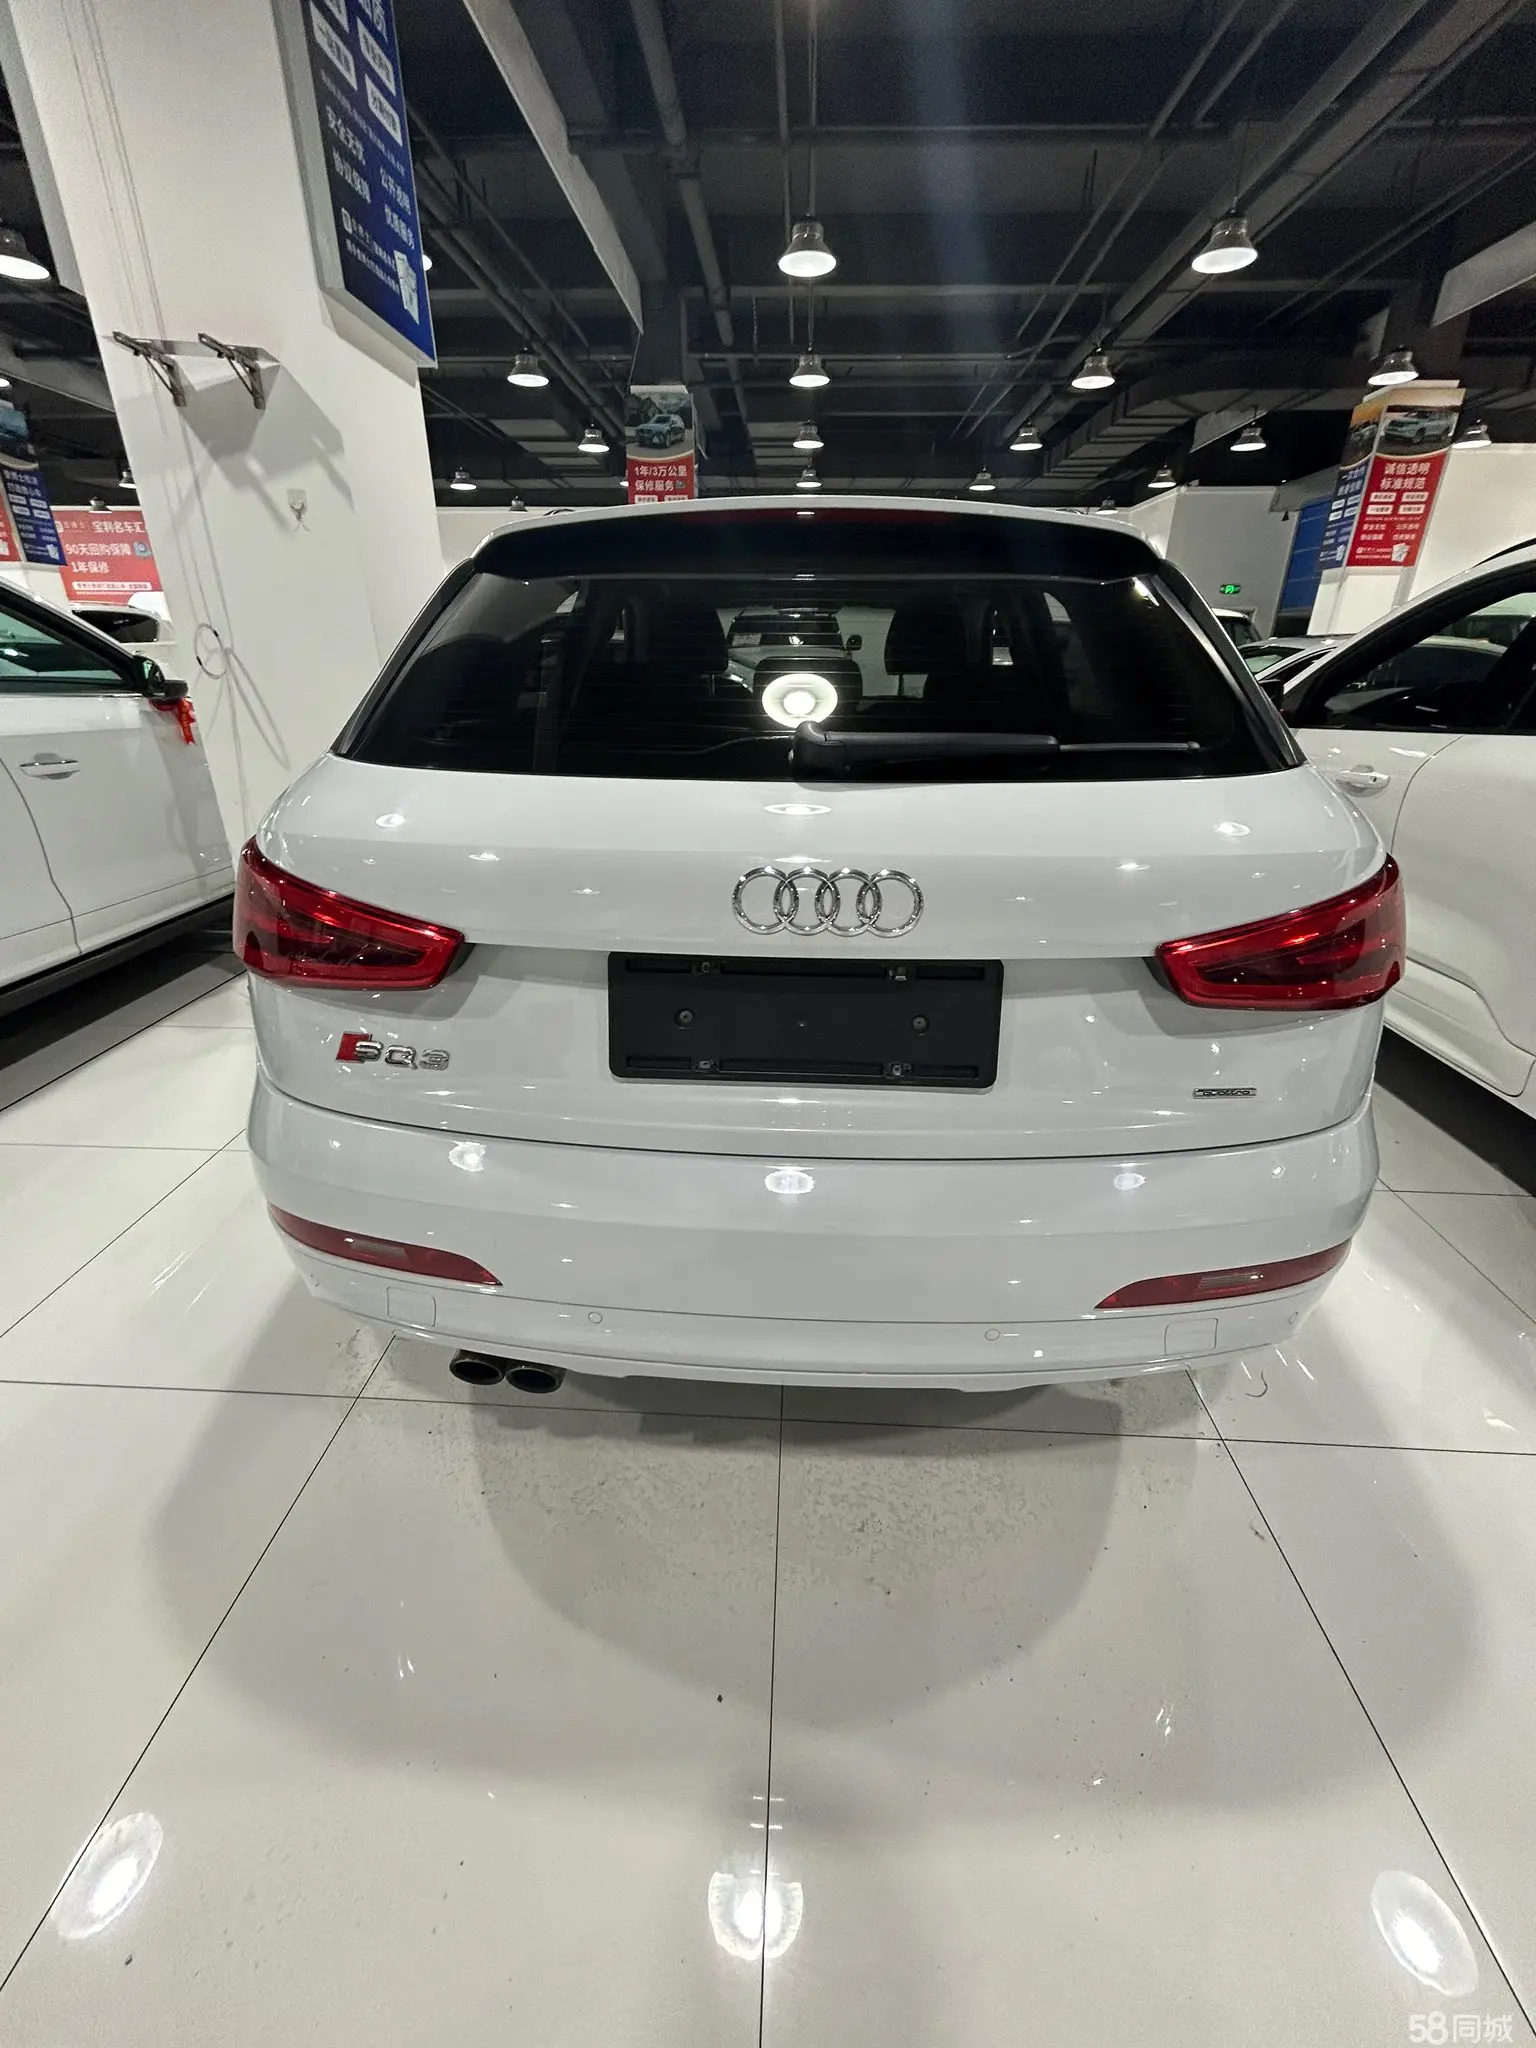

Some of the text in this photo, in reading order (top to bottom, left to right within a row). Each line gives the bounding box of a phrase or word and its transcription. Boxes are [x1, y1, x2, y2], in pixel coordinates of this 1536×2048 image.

[634, 465, 687, 477] 1年/3万公里
[1384, 462, 1430, 475] 诚信透明
[635, 480, 674, 492] 保修服务
[1380, 477, 1427, 490] 标准规范
[65, 543, 132, 556] 90天回购保障
[71, 561, 110, 574] 1年保修
[354, 1040, 451, 1071] SQ3
